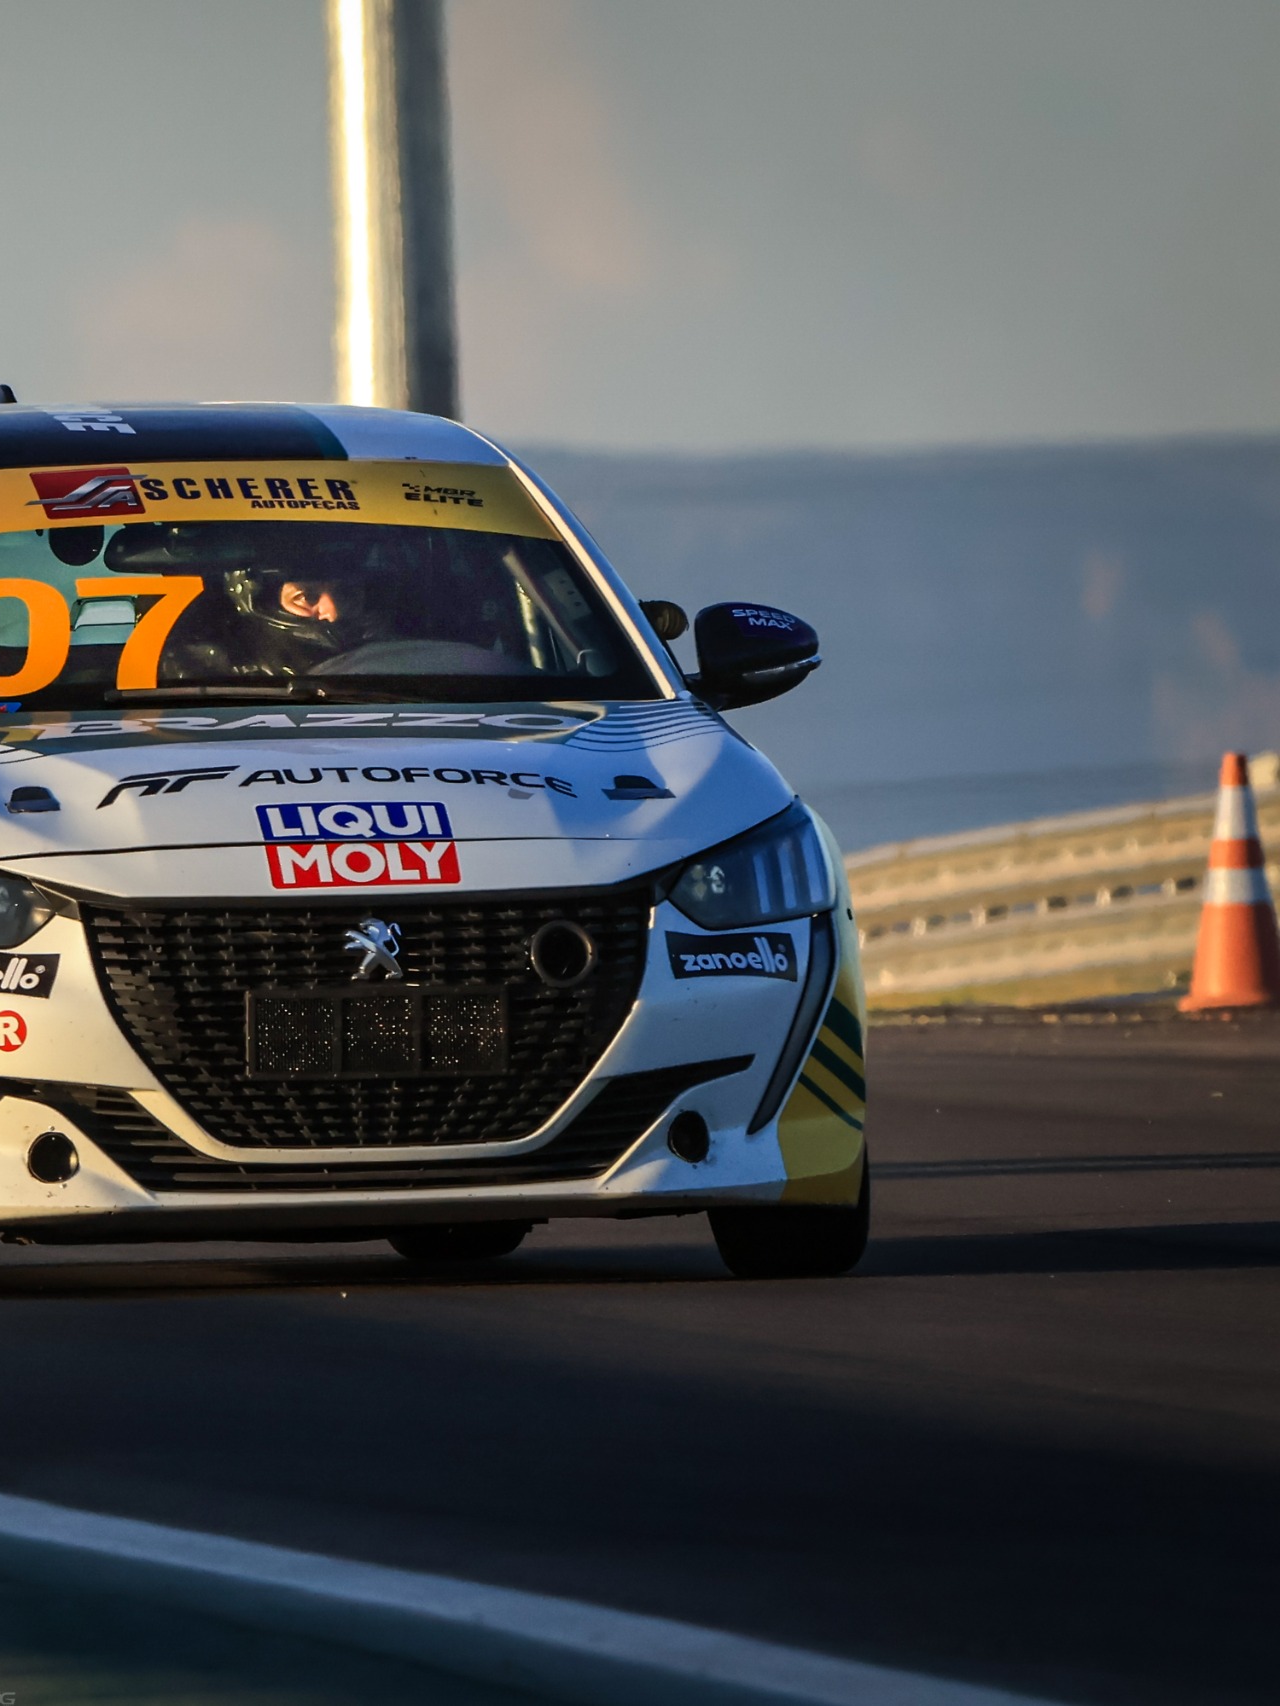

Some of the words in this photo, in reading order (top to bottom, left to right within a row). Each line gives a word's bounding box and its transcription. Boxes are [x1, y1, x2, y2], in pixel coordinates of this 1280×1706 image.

[139, 477, 357, 501] SCHERER
[403, 491, 484, 508] ELITE
[422, 484, 478, 498] MBR
[250, 499, 361, 511] AUTOPEÇAS
[731, 608, 796, 624] SPEED
[748, 617, 793, 631] MAX
[12, 712, 586, 741] BRAZZO
[238, 766, 578, 799] AUTOFORCE
[265, 803, 443, 838] LIQUI
[276, 841, 452, 885] MOLY
[680, 936, 789, 973] zanoello
